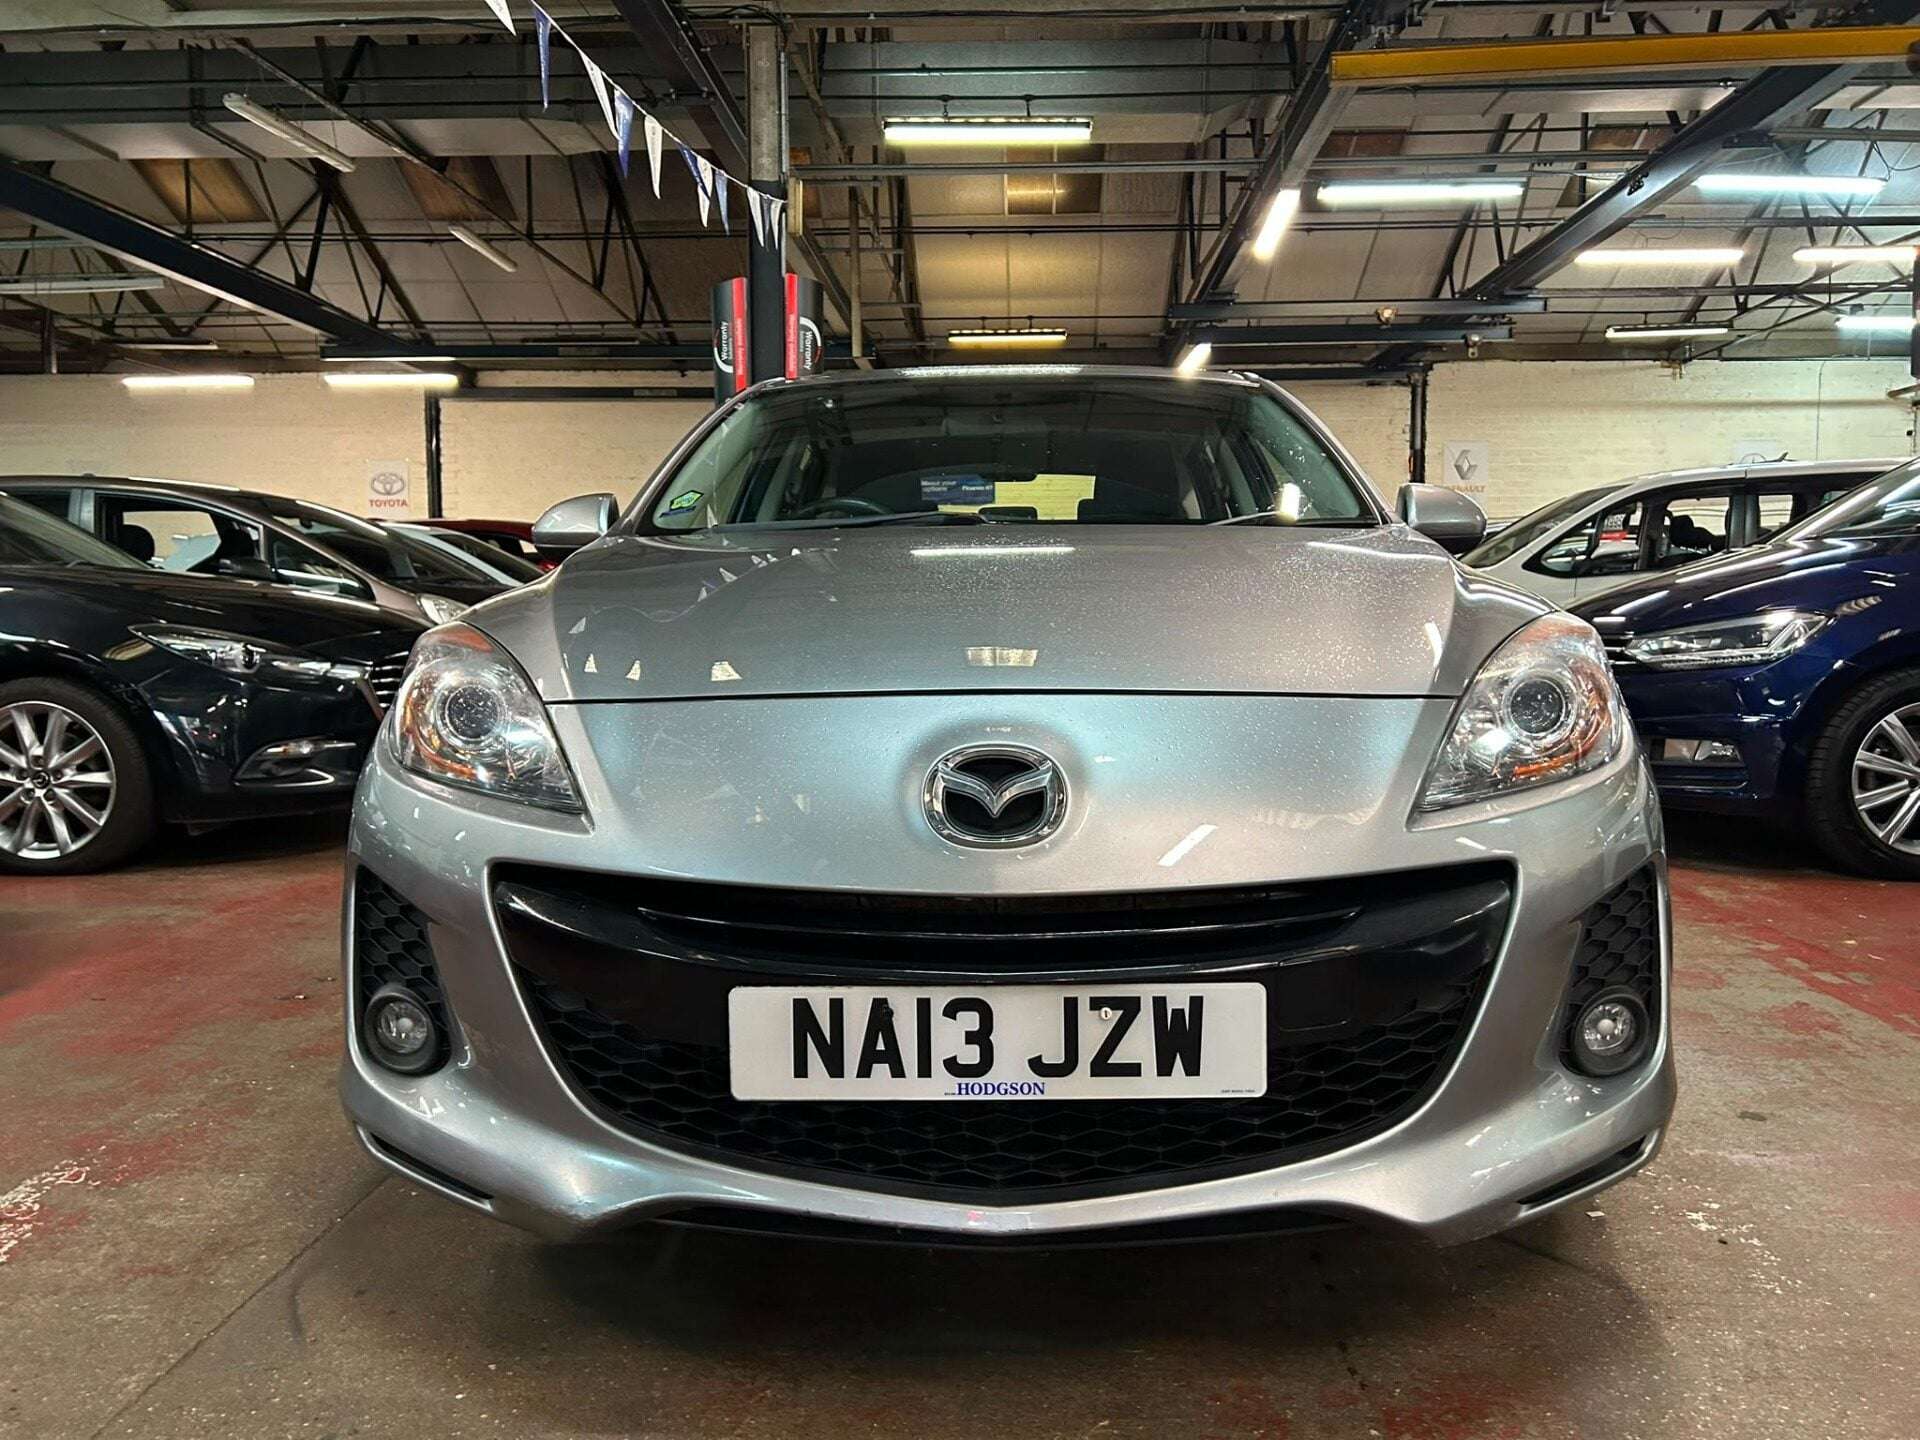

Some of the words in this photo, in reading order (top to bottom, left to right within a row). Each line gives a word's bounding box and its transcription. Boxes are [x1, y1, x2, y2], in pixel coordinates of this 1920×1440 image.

[720, 321, 729, 361] Warranty
[803, 330, 813, 370] Warranty
[369, 499, 408, 508] TOYOTA
[792, 997, 995, 1079] NA13
[1027, 995, 1204, 1078] JZW
[957, 1082, 1045, 1096] HODGSON
